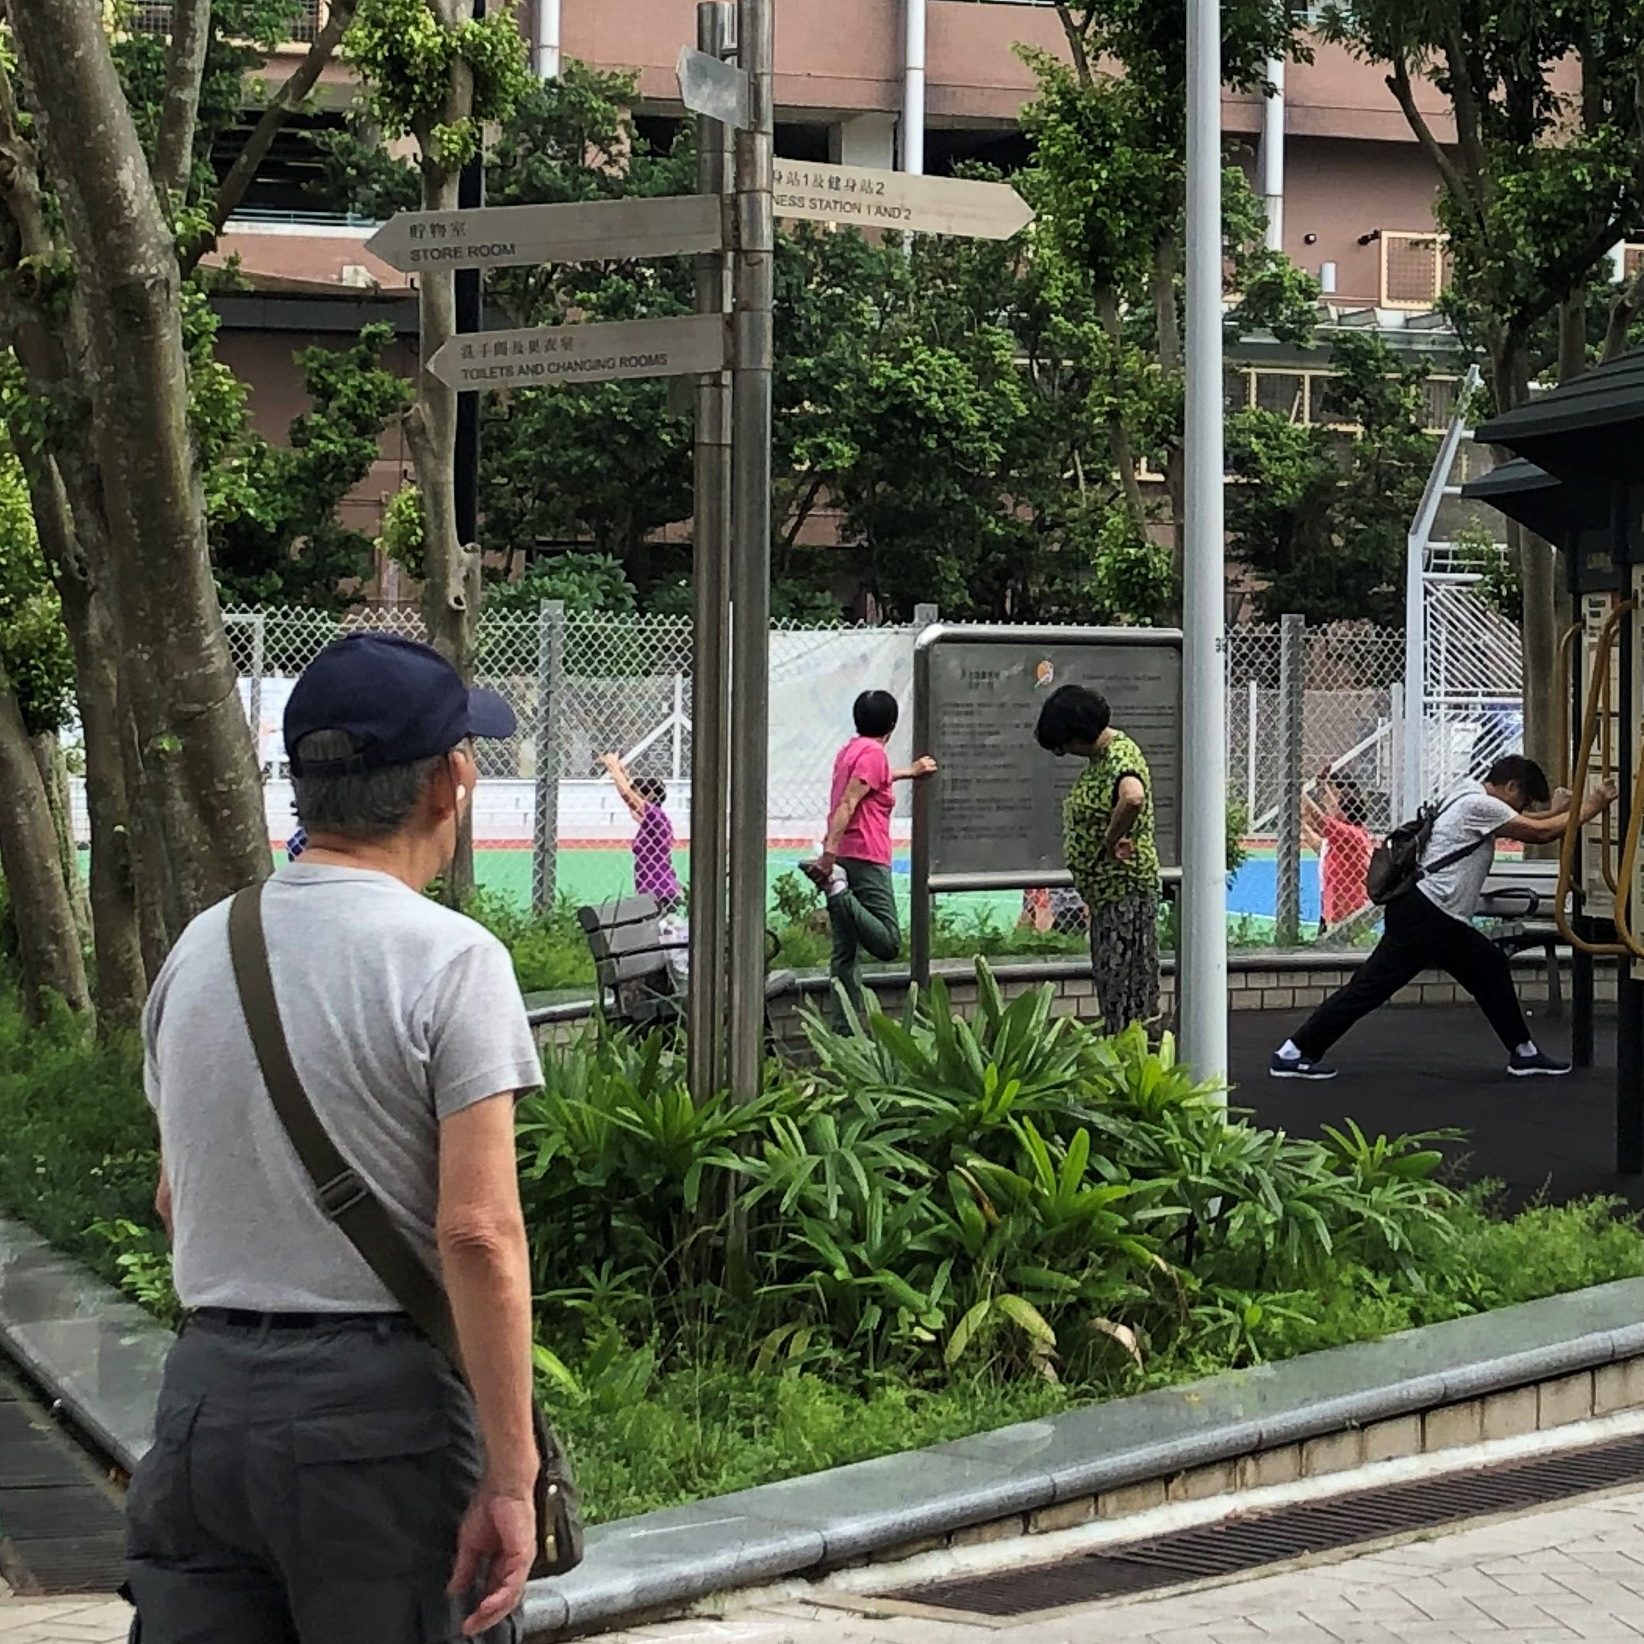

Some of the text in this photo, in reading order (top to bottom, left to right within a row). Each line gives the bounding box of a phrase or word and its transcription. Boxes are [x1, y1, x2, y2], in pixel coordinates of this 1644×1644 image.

[808, 198, 862, 214] STATION
[874, 205, 901, 219] AND
[903, 208, 912, 221] 2
[409, 242, 517, 262] STORE ROOM
[461, 353, 669, 380] TOILETS AND CHANGING ROOMS
